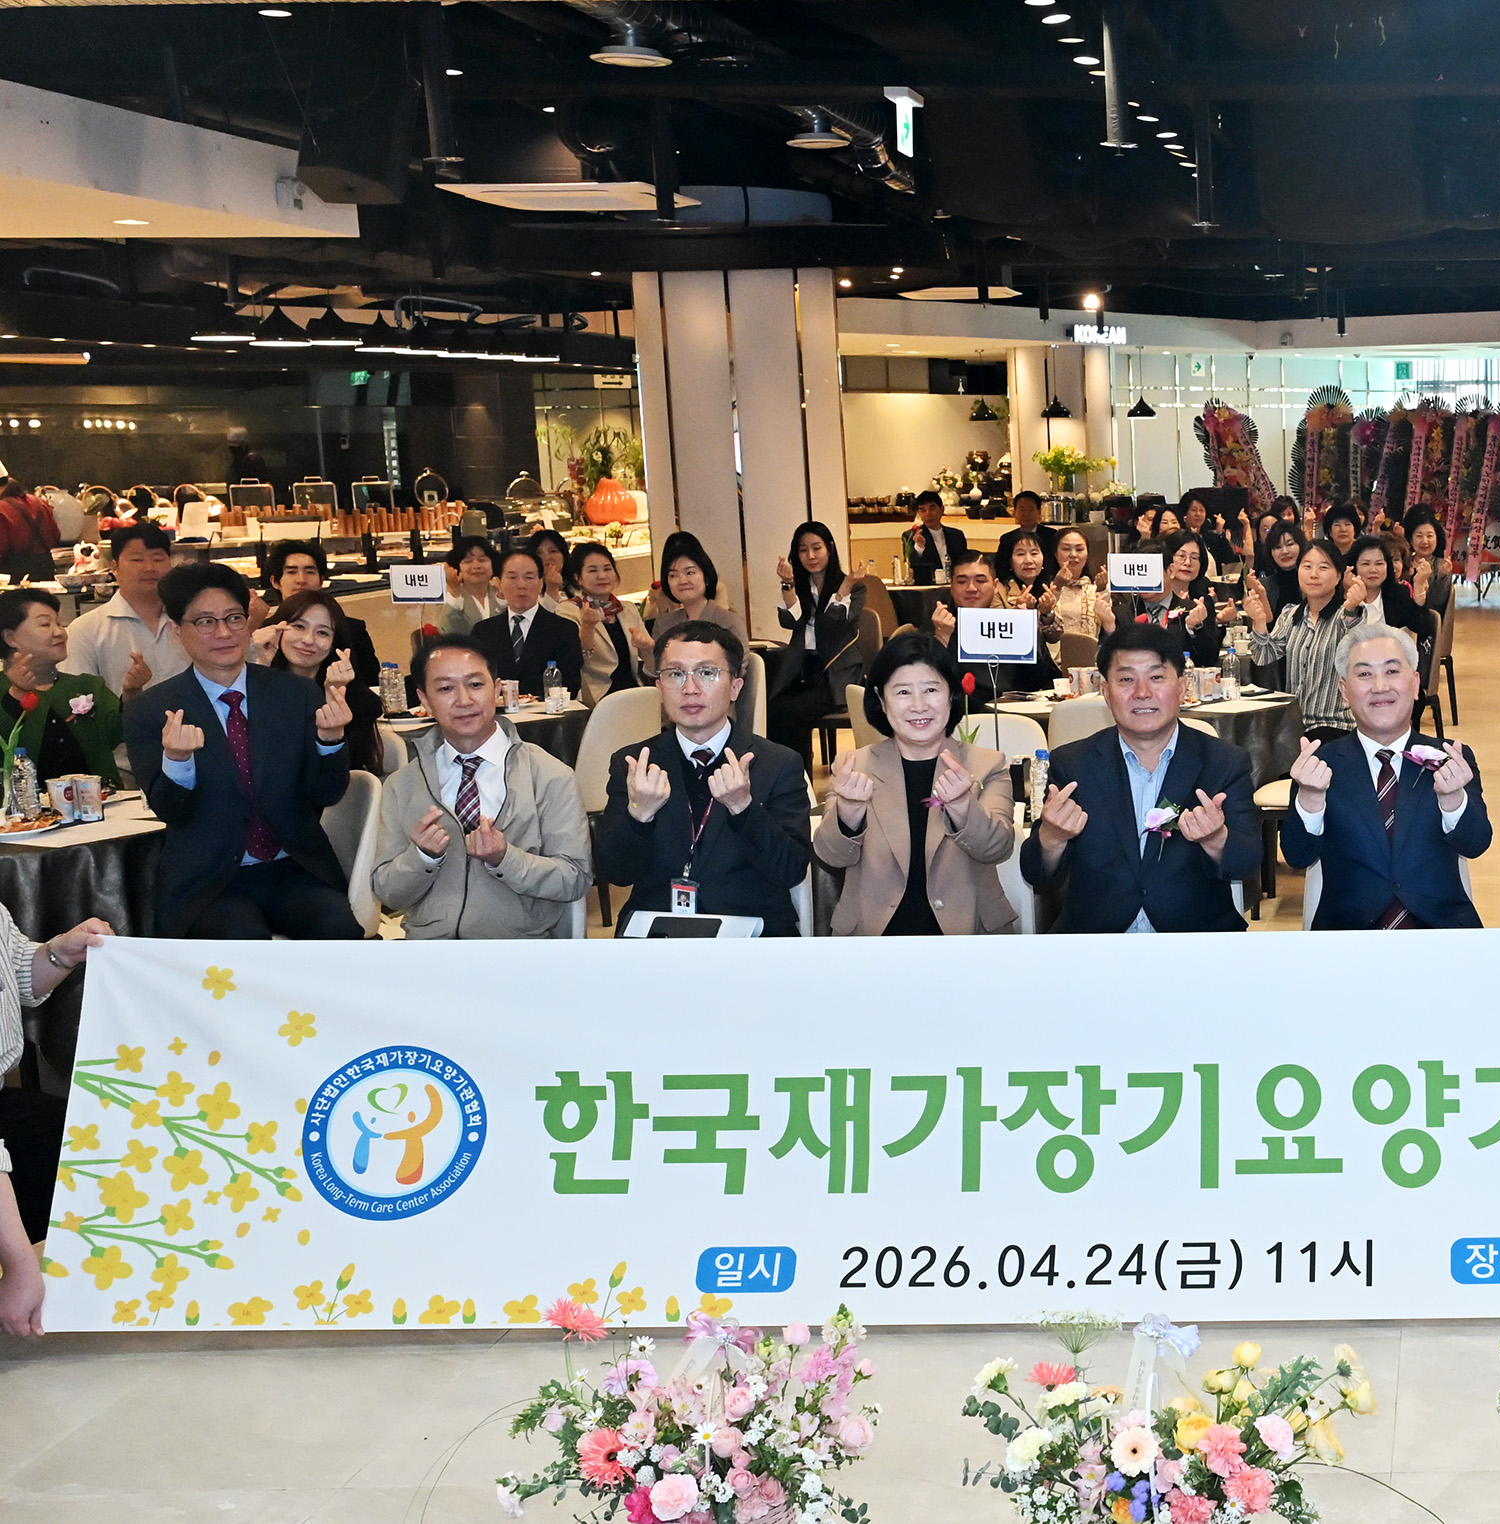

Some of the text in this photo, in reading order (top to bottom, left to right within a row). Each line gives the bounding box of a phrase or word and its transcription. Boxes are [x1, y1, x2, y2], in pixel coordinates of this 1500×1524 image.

[1124, 563, 1148, 577] 내빈
[404, 573, 429, 587] 내빈
[980, 621, 1014, 640] 내빈
[310, 1151, 473, 1213] Korea Long-Term Care Center Association
[713, 1252, 784, 1288] 일시
[840, 1239, 1246, 1293] 2026.04.24(금)
[1266, 1239, 1376, 1288] 11시
